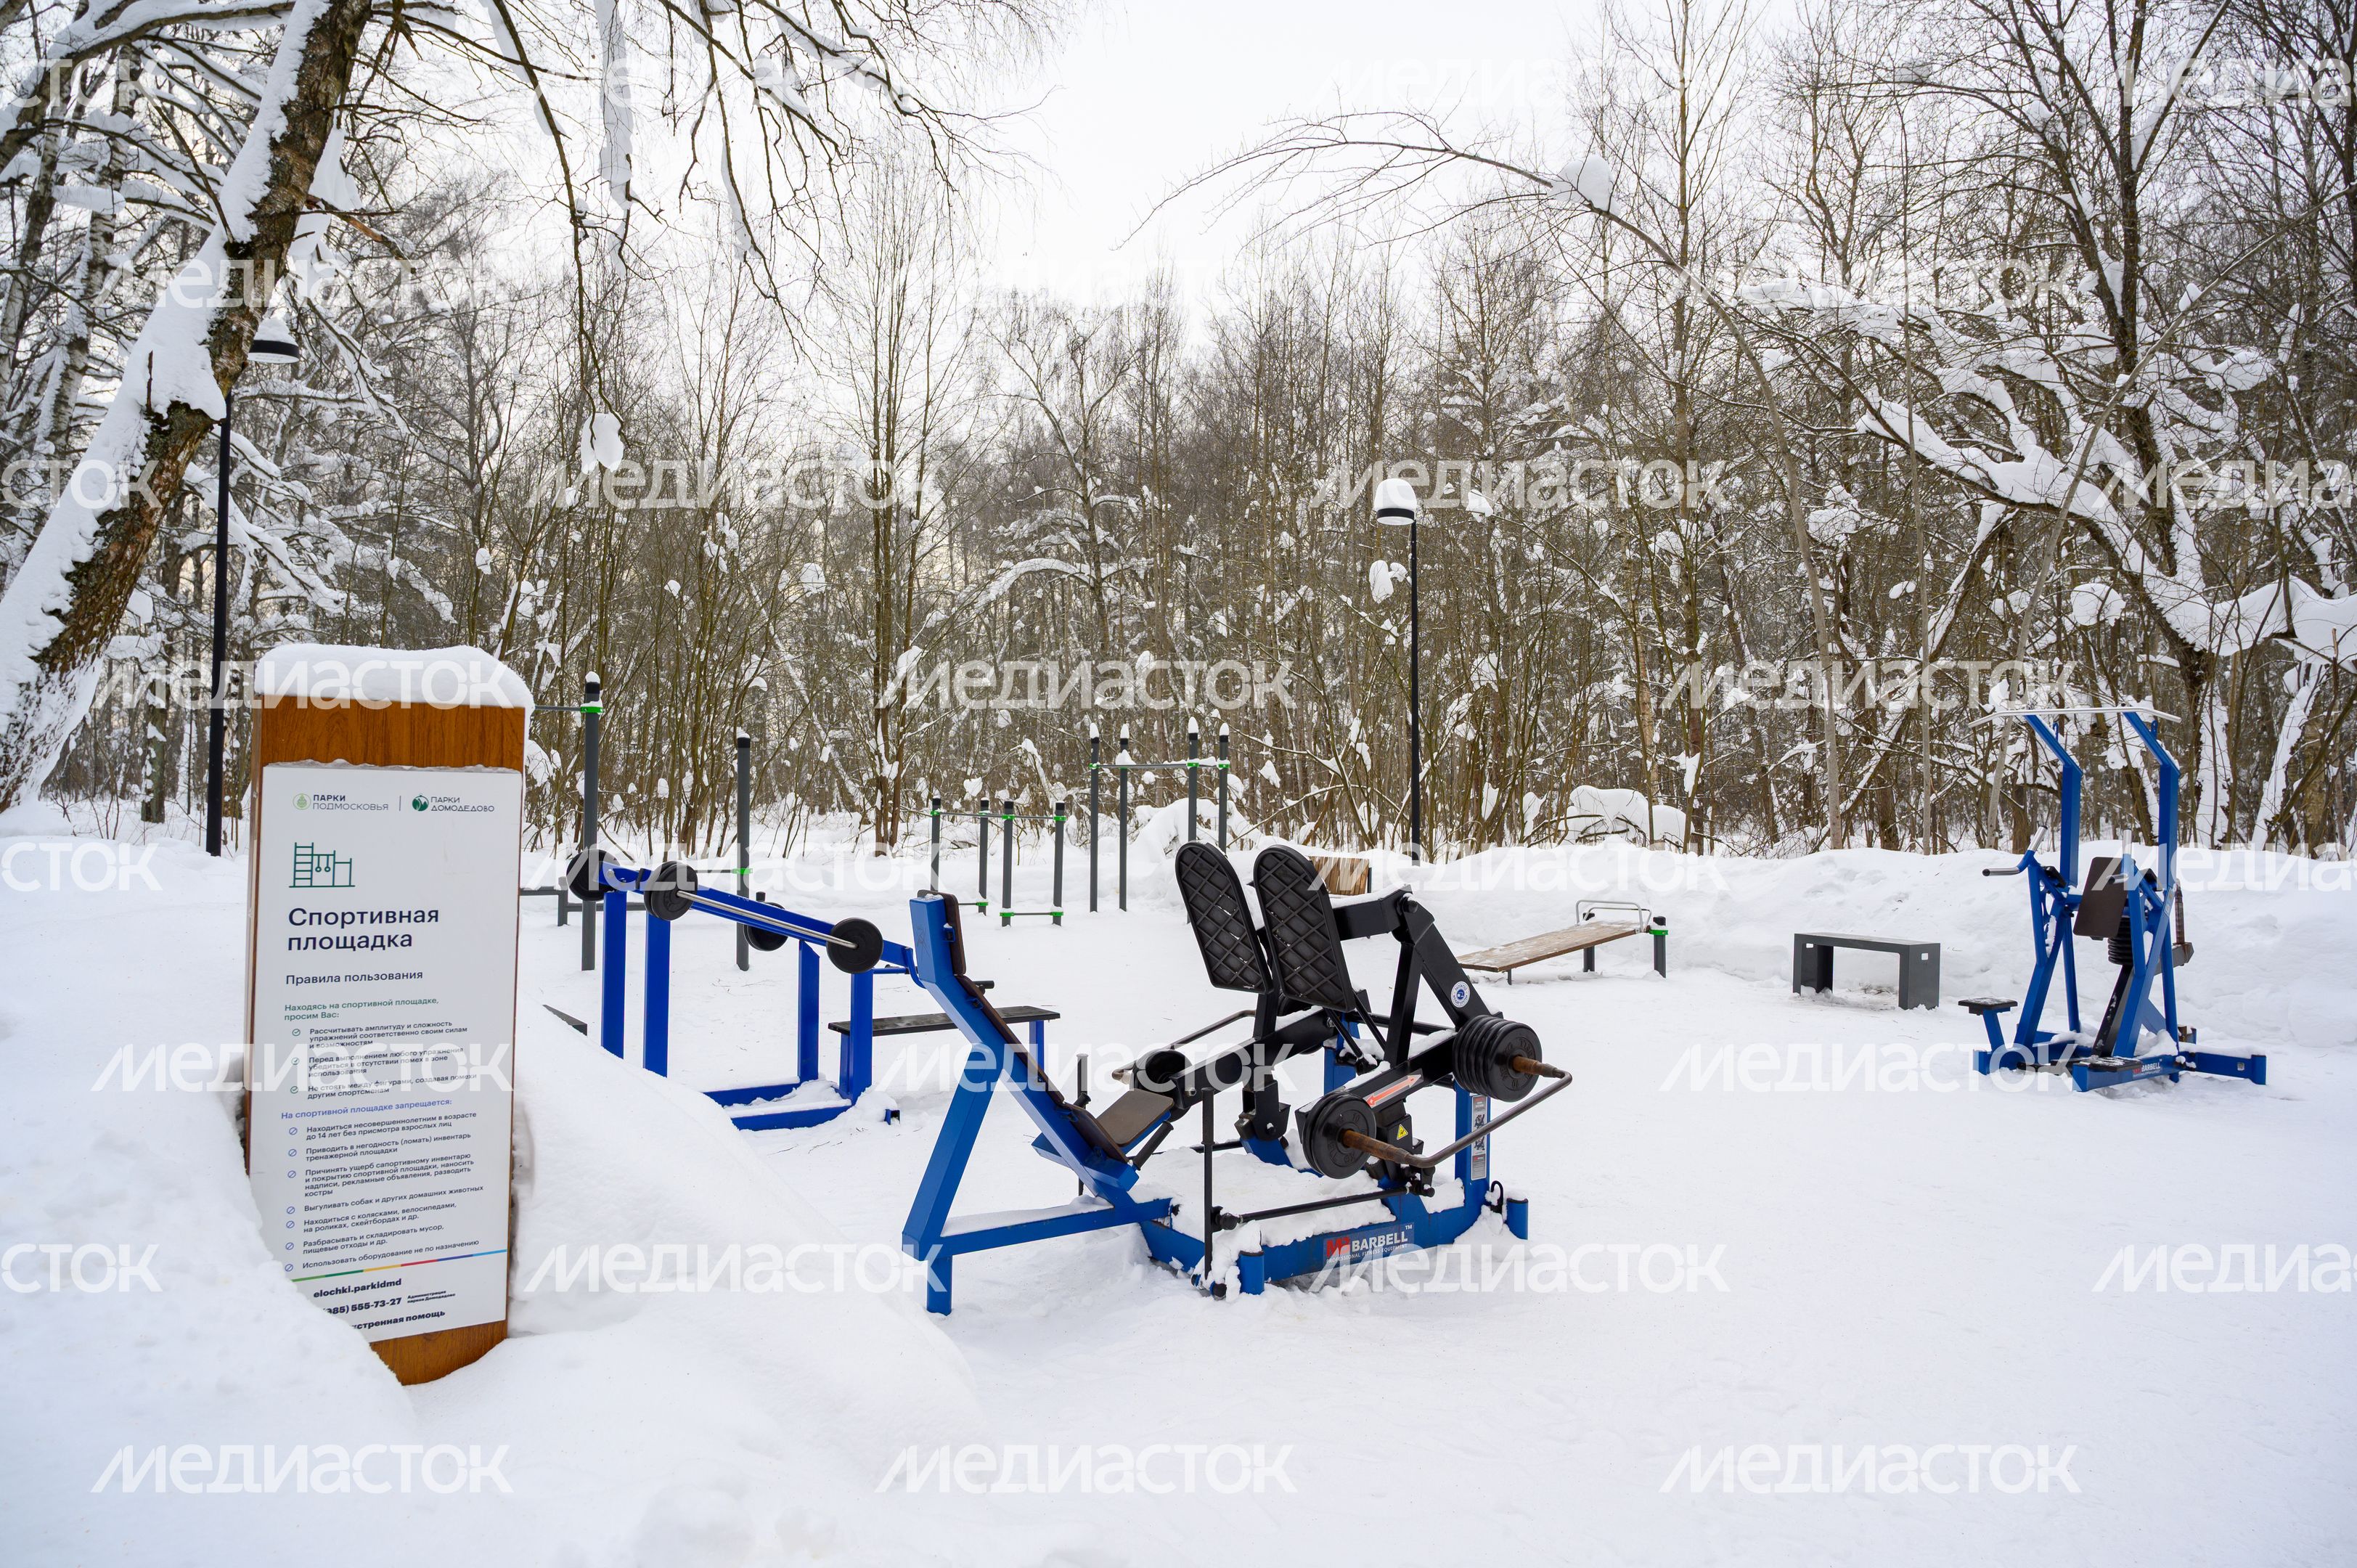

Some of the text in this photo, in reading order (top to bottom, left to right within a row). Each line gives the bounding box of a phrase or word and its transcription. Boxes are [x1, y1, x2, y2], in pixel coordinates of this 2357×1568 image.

[288, 907, 439, 928] Спортивная
[287, 934, 412, 952] площадка
[286, 972, 422, 985] Правила пользования
[341, 999, 393, 1009] спортивной
[309, 1033, 357, 1043] упражнений
[359, 1030, 419, 1039] соответственно
[295, 1106, 348, 1118] спортивной
[350, 1104, 393, 1113] площадке
[395, 1099, 452, 1109] запрещается:
[306, 1124, 351, 1132] Находиться
[354, 1116, 436, 1128] несовершеннолетним
[358, 1127, 399, 1135] присмотра
[306, 1146, 348, 1155] Приводить
[356, 1140, 399, 1149] негодность
[400, 1136, 431, 1146] (ломать)
[305, 1153, 470, 1176] Причинять ущерб сапортивному инвентарю
[306, 1150, 358, 1161] тренажерной
[305, 1167, 470, 1190] надписи, рекламные объявления, разводить
[311, 1173, 351, 1182] покрытию
[353, 1167, 398, 1177] спортивной
[400, 1164, 438, 1172] площадки,
[304, 1201, 348, 1212] Выгуливать
[381, 1195, 407, 1204] других
[409, 1190, 446, 1200] домашних
[449, 1185, 483, 1194] животных
[303, 1215, 349, 1225] Находиться
[357, 1209, 399, 1219] колясками,
[401, 1202, 456, 1214] велосипедами,
[314, 1222, 348, 1233] роликах,
[351, 1217, 399, 1227] скейтбордах
[303, 1236, 357, 1247] Разбрасывать
[366, 1228, 417, 1239] складировать
[1352, 1231, 1408, 1252] BARBELL
[303, 1245, 338, 1254] пищевые
[303, 1257, 356, 1269] Использовать
[358, 1249, 412, 1261] оборудование
[436, 1240, 479, 1250] назначению
[313, 1278, 401, 1297] elochki.parkidmd
[351, 1297, 401, 1310] 555-73-27
[406, 1311, 445, 1322] помощь
